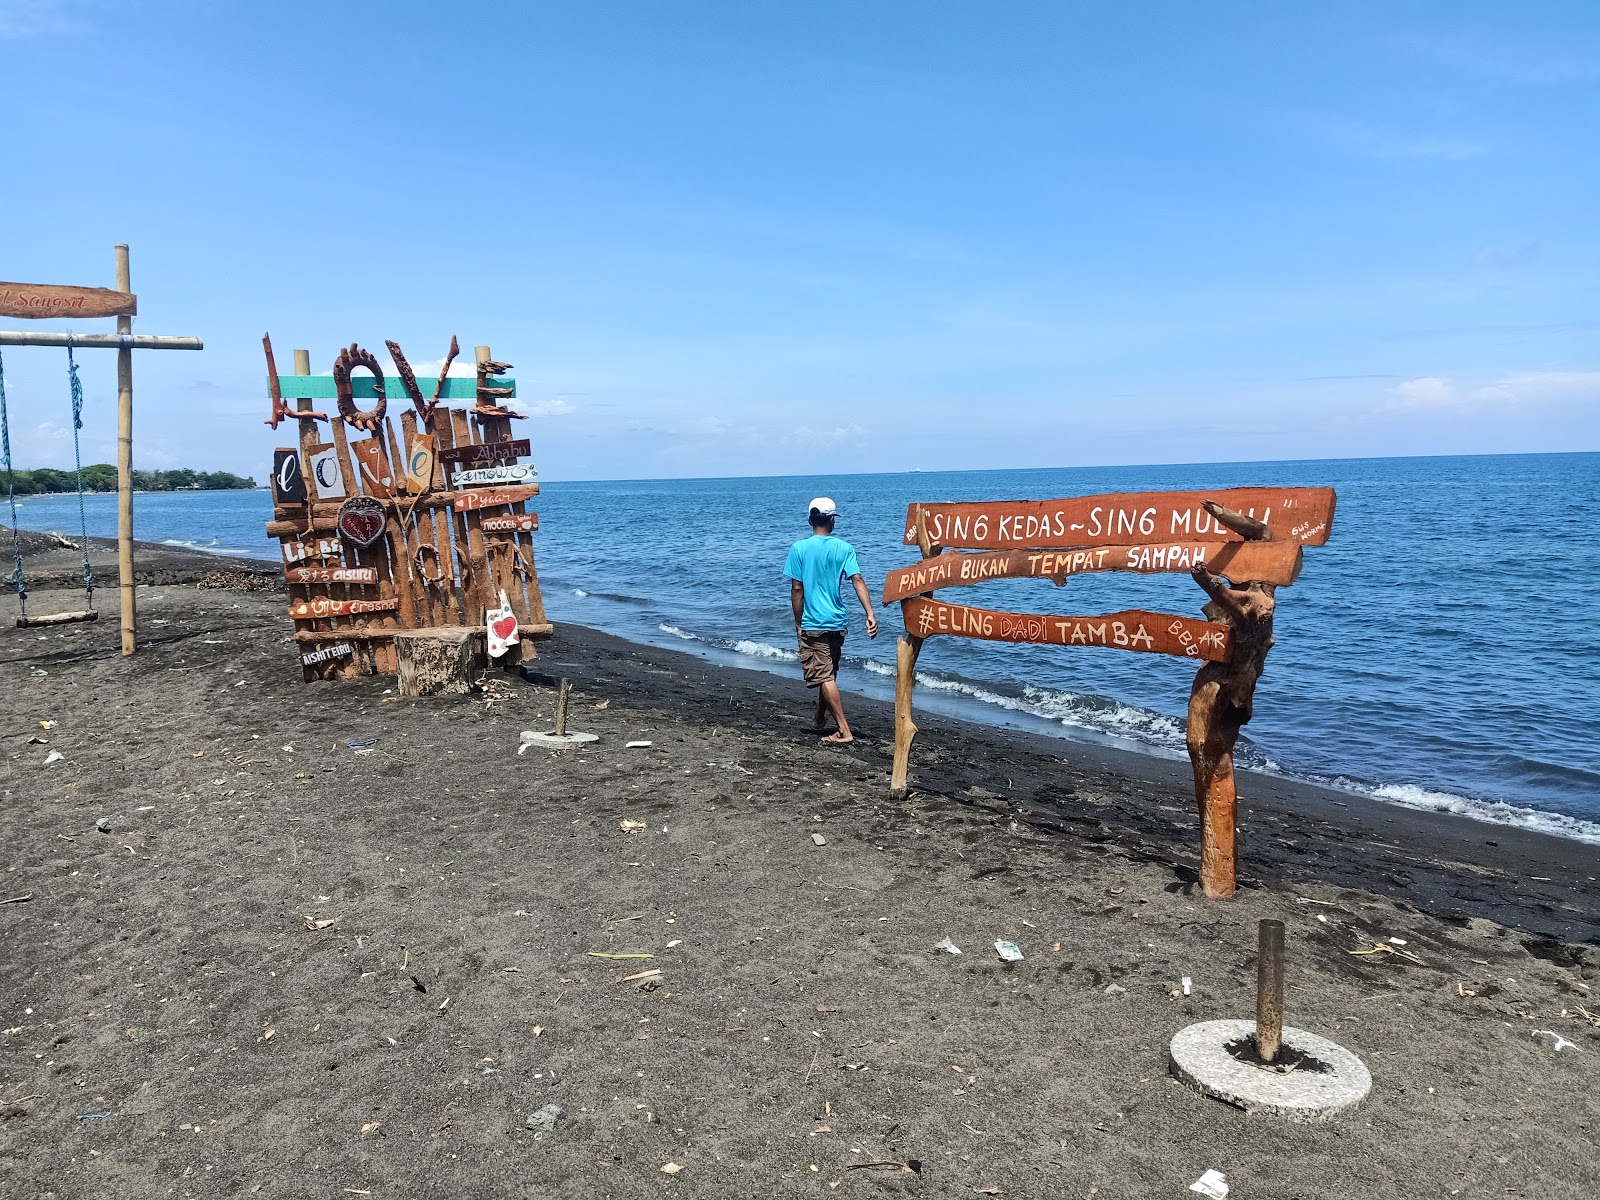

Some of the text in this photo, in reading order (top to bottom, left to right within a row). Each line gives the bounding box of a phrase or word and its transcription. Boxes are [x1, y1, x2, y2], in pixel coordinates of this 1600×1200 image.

[461, 493, 515, 510] Pyaar
[898, 545, 1207, 594] PANTAI BUKAN TEMPAT SAMPAH
[1055, 621, 1154, 650] TAMBA
